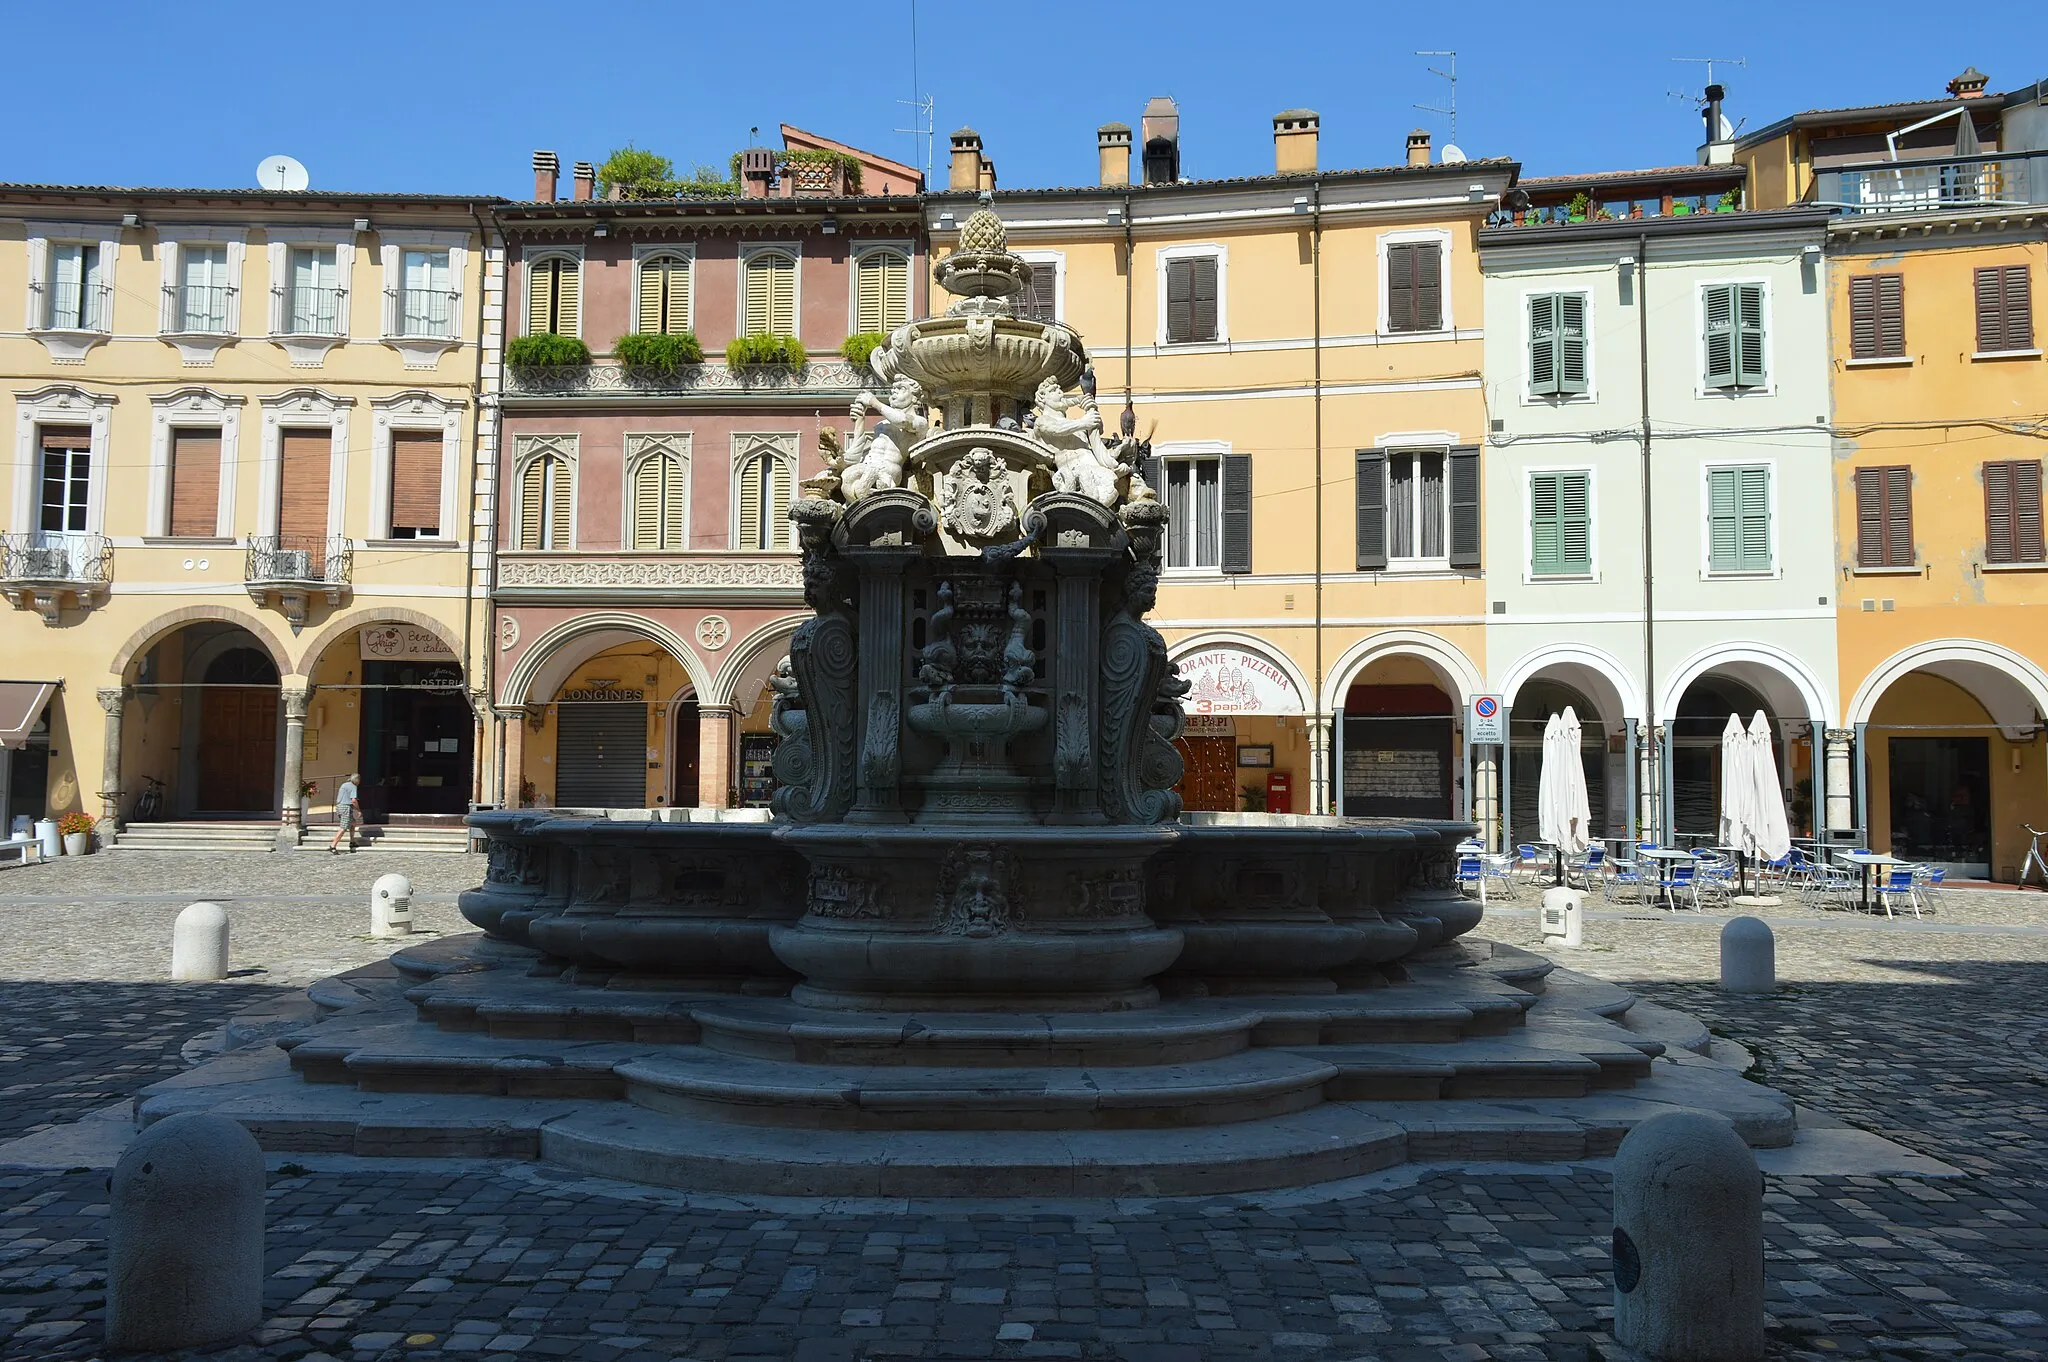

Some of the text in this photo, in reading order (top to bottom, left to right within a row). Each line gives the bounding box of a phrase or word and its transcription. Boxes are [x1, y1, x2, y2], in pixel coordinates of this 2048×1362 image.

[408, 630, 433, 642] Bere
[409, 643, 419, 653] in
[1179, 653, 1226, 675] ORANTE
[1241, 655, 1289, 690] PIZZERIA
[562, 689, 643, 701] LONGINES
[1201, 715, 1228, 727] PAPI
